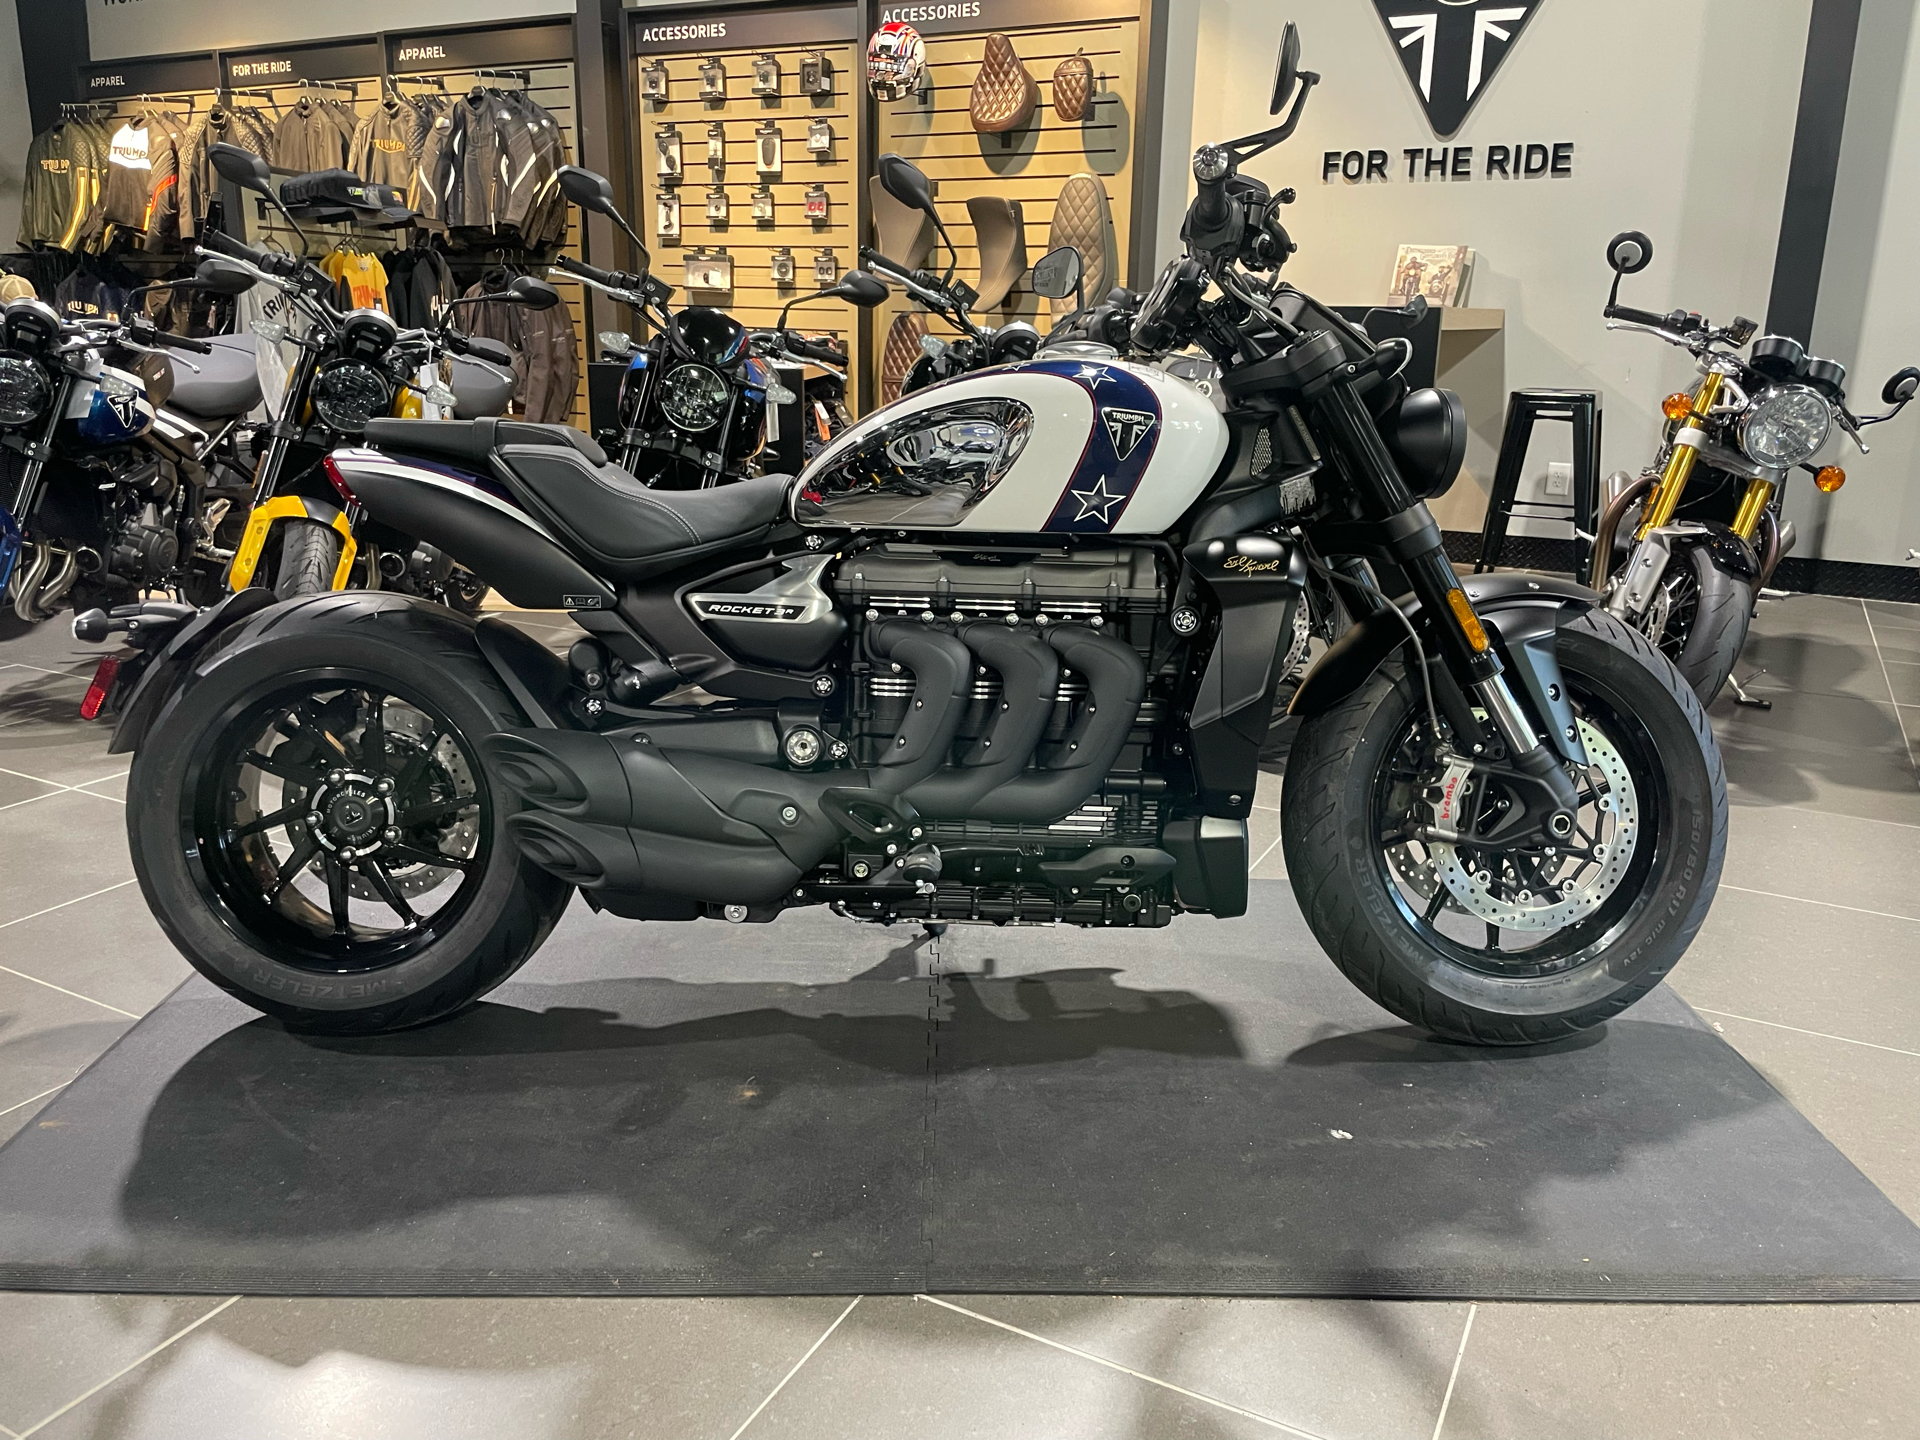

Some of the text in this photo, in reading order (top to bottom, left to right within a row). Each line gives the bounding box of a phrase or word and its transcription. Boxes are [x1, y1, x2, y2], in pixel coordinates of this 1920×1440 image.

[882, 1, 981, 24] ACCESSORIES
[642, 22, 727, 42] ACCESSORIES
[398, 46, 446, 61] APPAREL
[232, 60, 292, 77] FOR THE RIDE
[90, 75, 126, 88] APPAREL
[112, 146, 147, 161] TRIUMP
[1322, 142, 1574, 184] FOR THE RIDE
[1111, 411, 1146, 425] TRIUMPH
[1440, 776, 1458, 820] brembo
[1354, 857, 1425, 964] METZELER
[252, 968, 388, 999] METZELER
